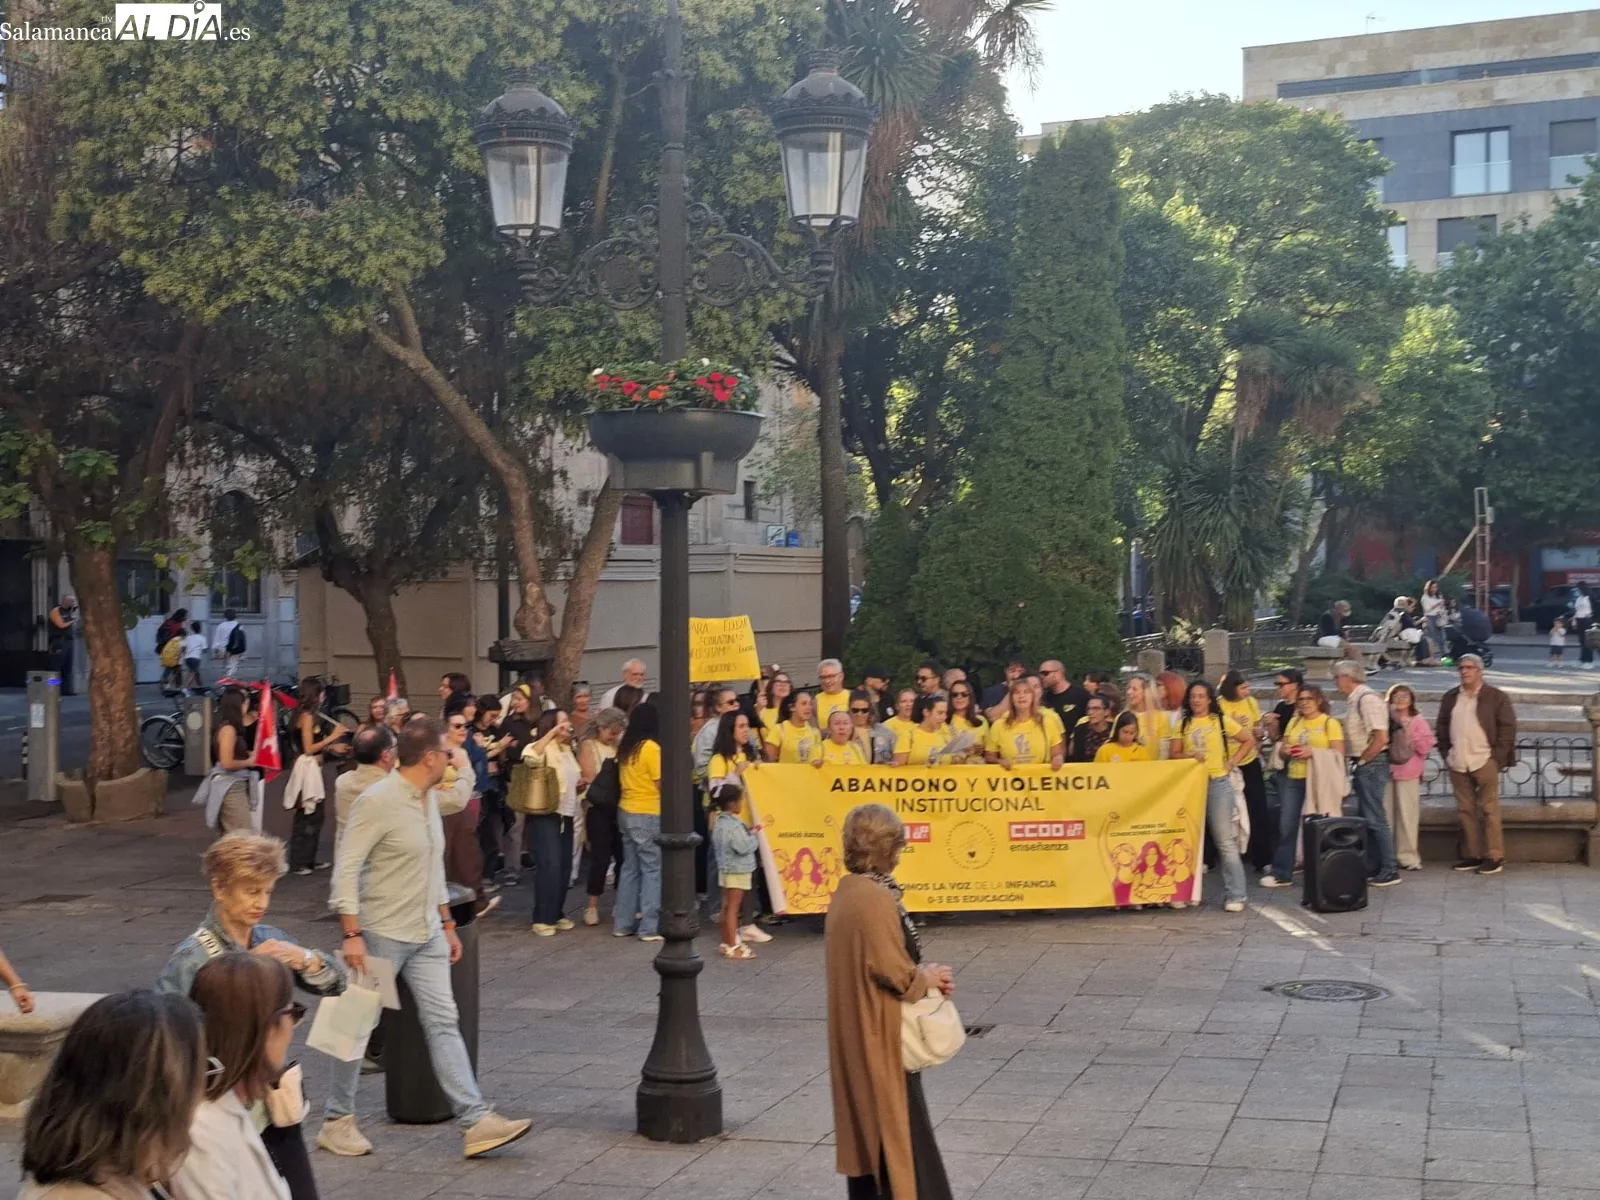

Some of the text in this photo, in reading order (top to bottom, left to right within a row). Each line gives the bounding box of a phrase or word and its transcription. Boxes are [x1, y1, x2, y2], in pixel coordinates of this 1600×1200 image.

[830, 775, 1110, 793] ABANDONO Y VIOLENCIA
[895, 796, 1046, 813] INSTITUCIONAL
[1011, 823, 1065, 838] CCOO
[1010, 841, 1069, 852] enseñanza
[899, 880, 1057, 892] OMOS LA VOZ DE LA INFANCIA
[946, 895, 960, 903] ES
[962, 892, 1024, 903] EDUCACIÓN
